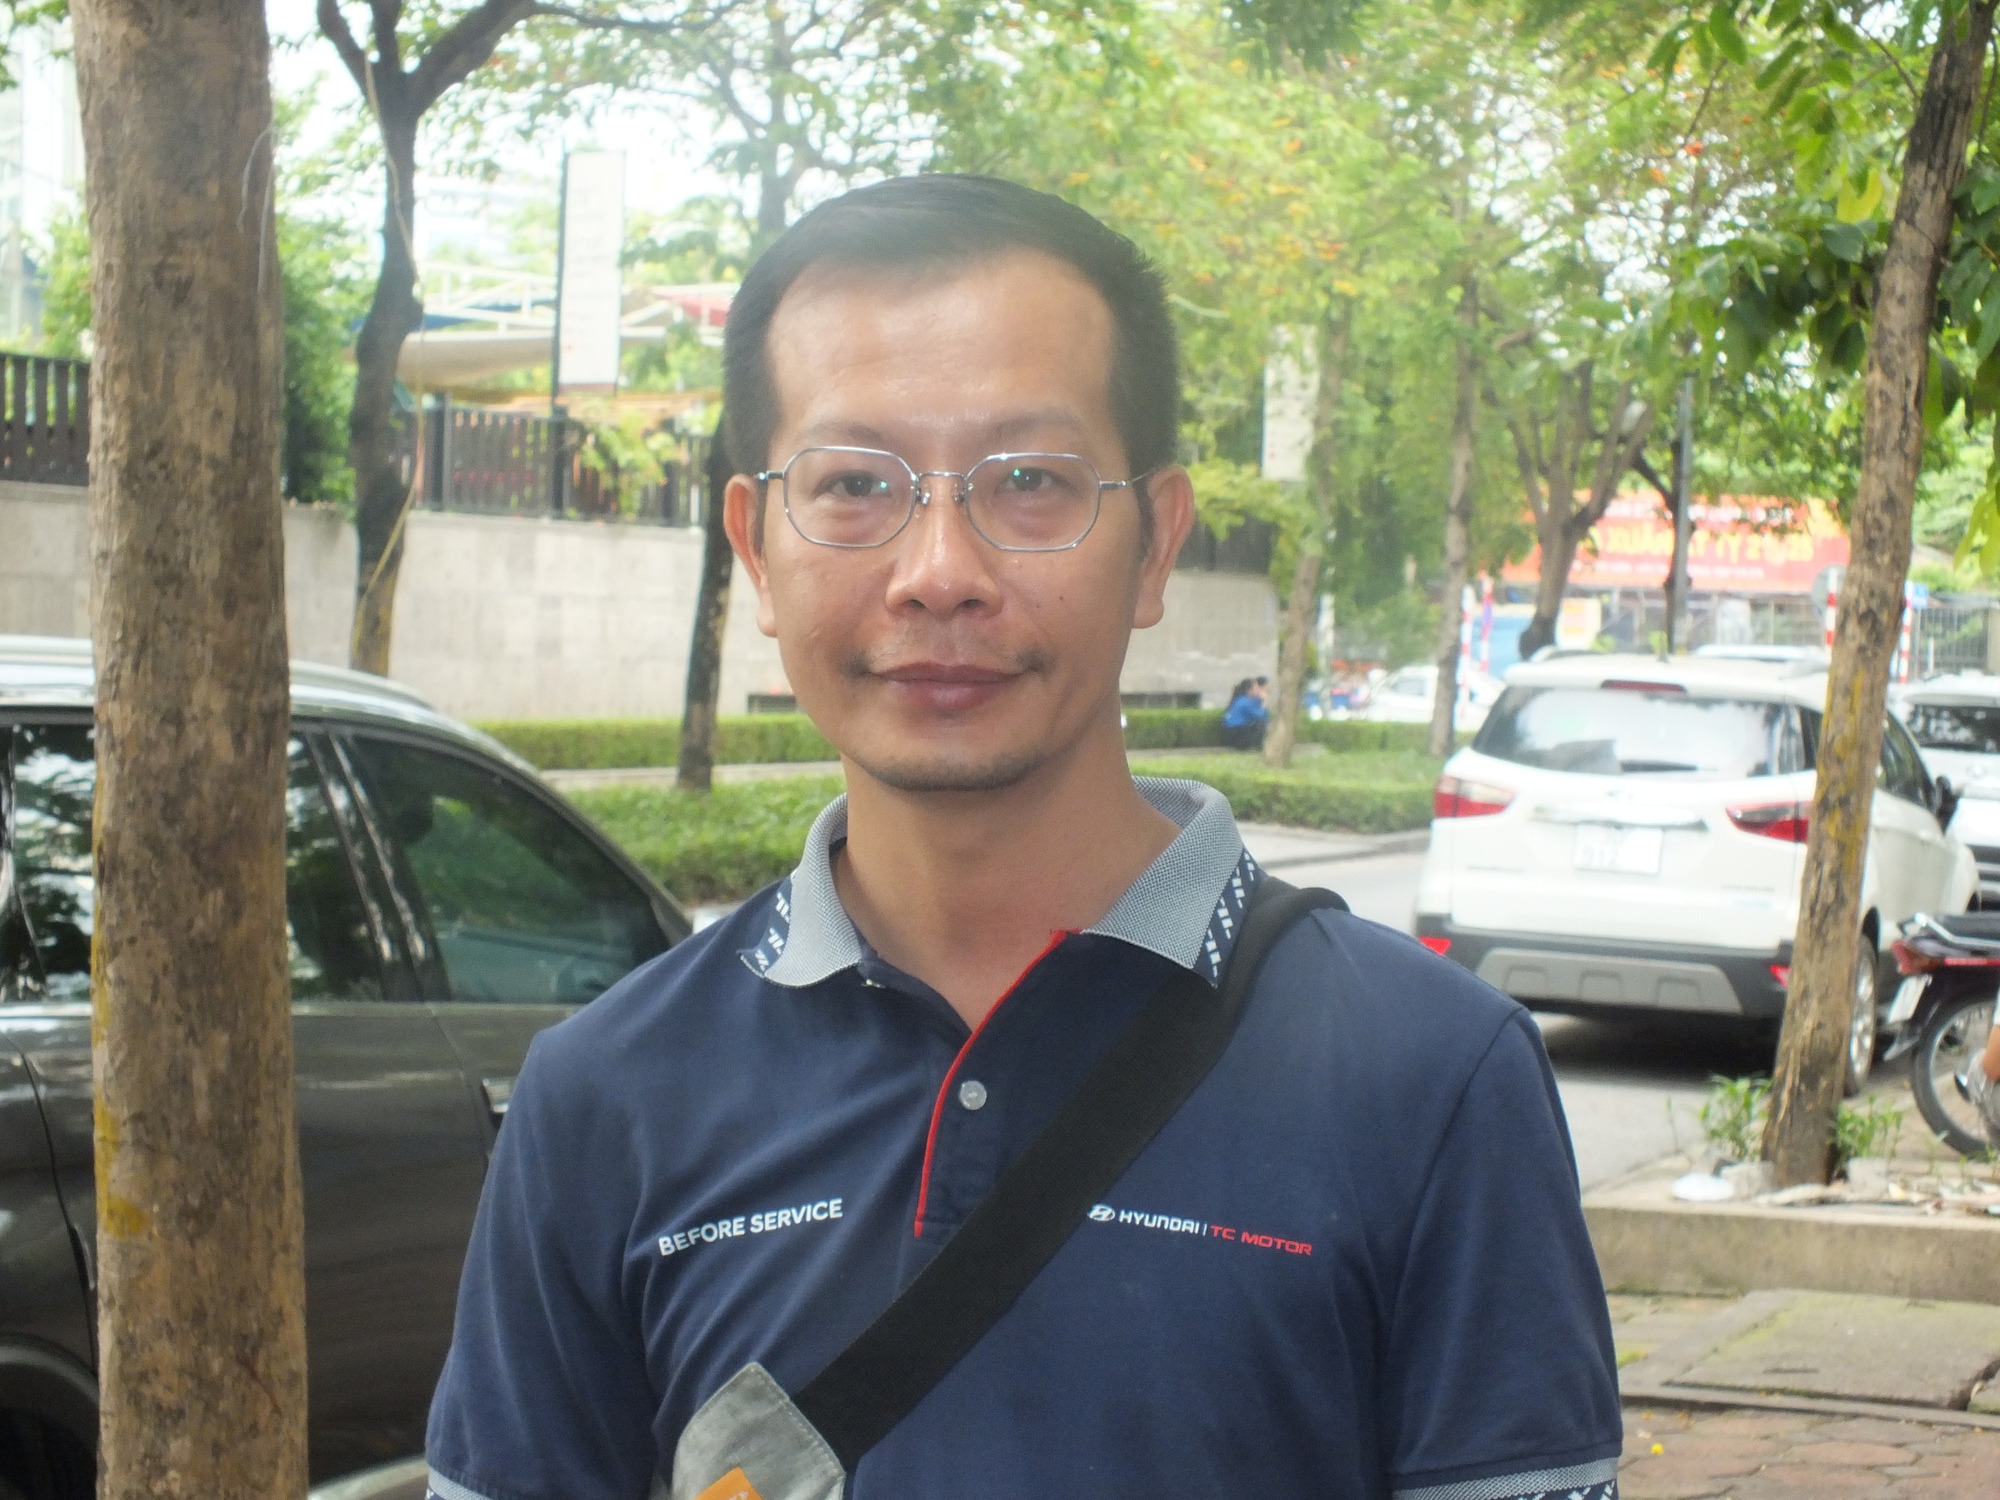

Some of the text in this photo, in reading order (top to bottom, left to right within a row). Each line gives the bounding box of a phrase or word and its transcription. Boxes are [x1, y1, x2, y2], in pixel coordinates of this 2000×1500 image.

[658, 1198, 843, 1256] BEFORE SERVICE
[1119, 1209, 1312, 1256] HYUNDAI TC MOTOR
